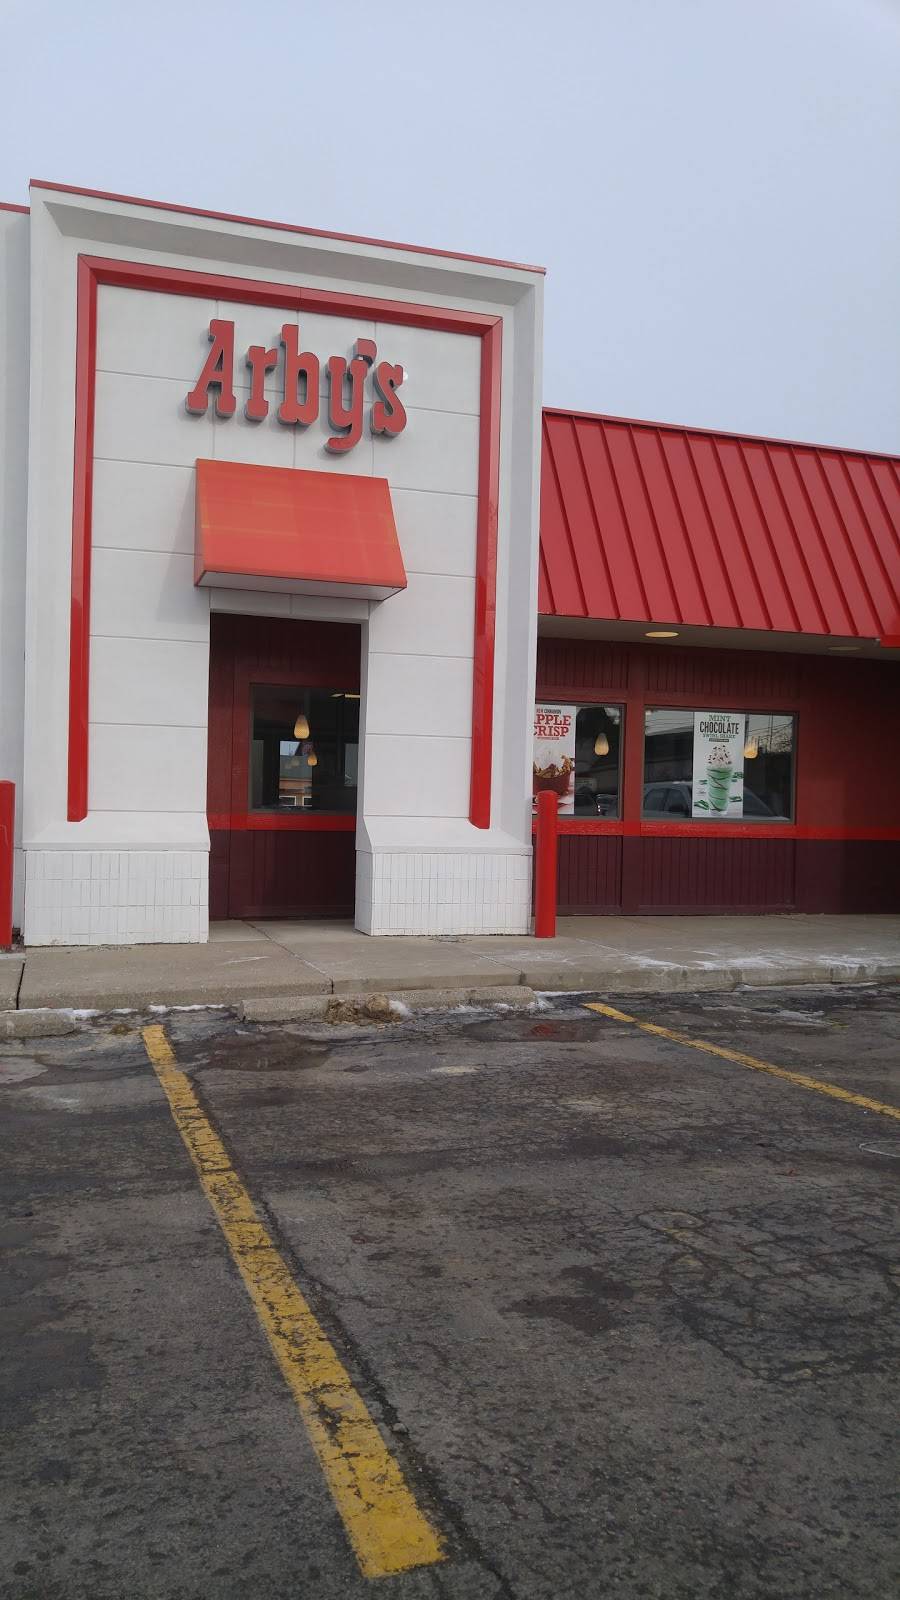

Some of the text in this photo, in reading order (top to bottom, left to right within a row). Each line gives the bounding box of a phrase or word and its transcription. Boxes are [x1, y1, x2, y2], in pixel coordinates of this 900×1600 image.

[186, 319, 407, 453] Arby's
[534, 714, 572, 726] PPLE
[708, 714, 732, 722] MINT
[699, 721, 740, 735] CHOCOLATE
